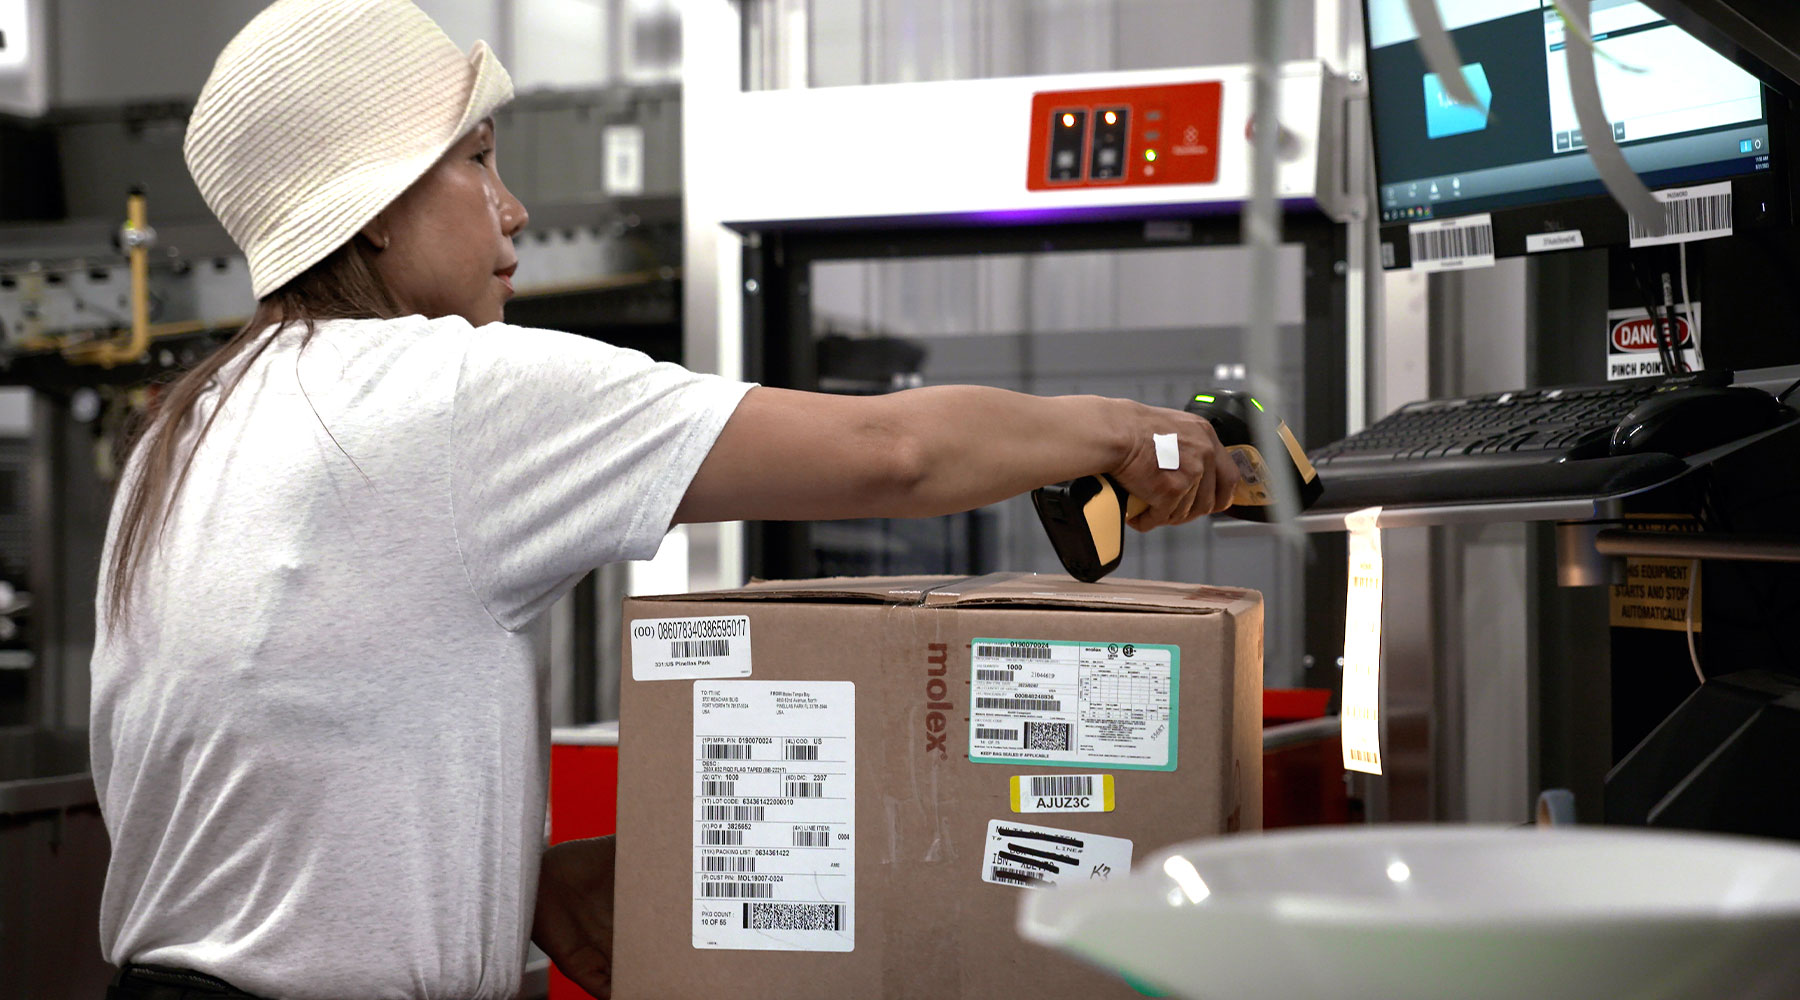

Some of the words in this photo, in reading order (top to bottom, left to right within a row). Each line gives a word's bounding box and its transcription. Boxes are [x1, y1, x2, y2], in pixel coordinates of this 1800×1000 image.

[1612, 363, 1637, 377] PINCH
[1641, 564, 1688, 580] EQUIPMENT
[1615, 583, 1645, 598] STARTS
[1647, 585, 1664, 600] AND
[1622, 604, 1686, 622] AUTOMATICALLY
[634, 626, 655, 639] (00)
[657, 619, 746, 640] 086078340386595017
[926, 643, 954, 753] molex
[738, 737, 773, 745] 0190070024
[813, 738, 823, 746] US
[725, 773, 739, 781] 1000
[1036, 797, 1090, 809] AJUZ3C
[837, 833, 850, 841] 0004
[715, 849, 739, 857] PACKING
[1055, 845, 1084, 855] LINE#
[709, 874, 723, 882] CUST
